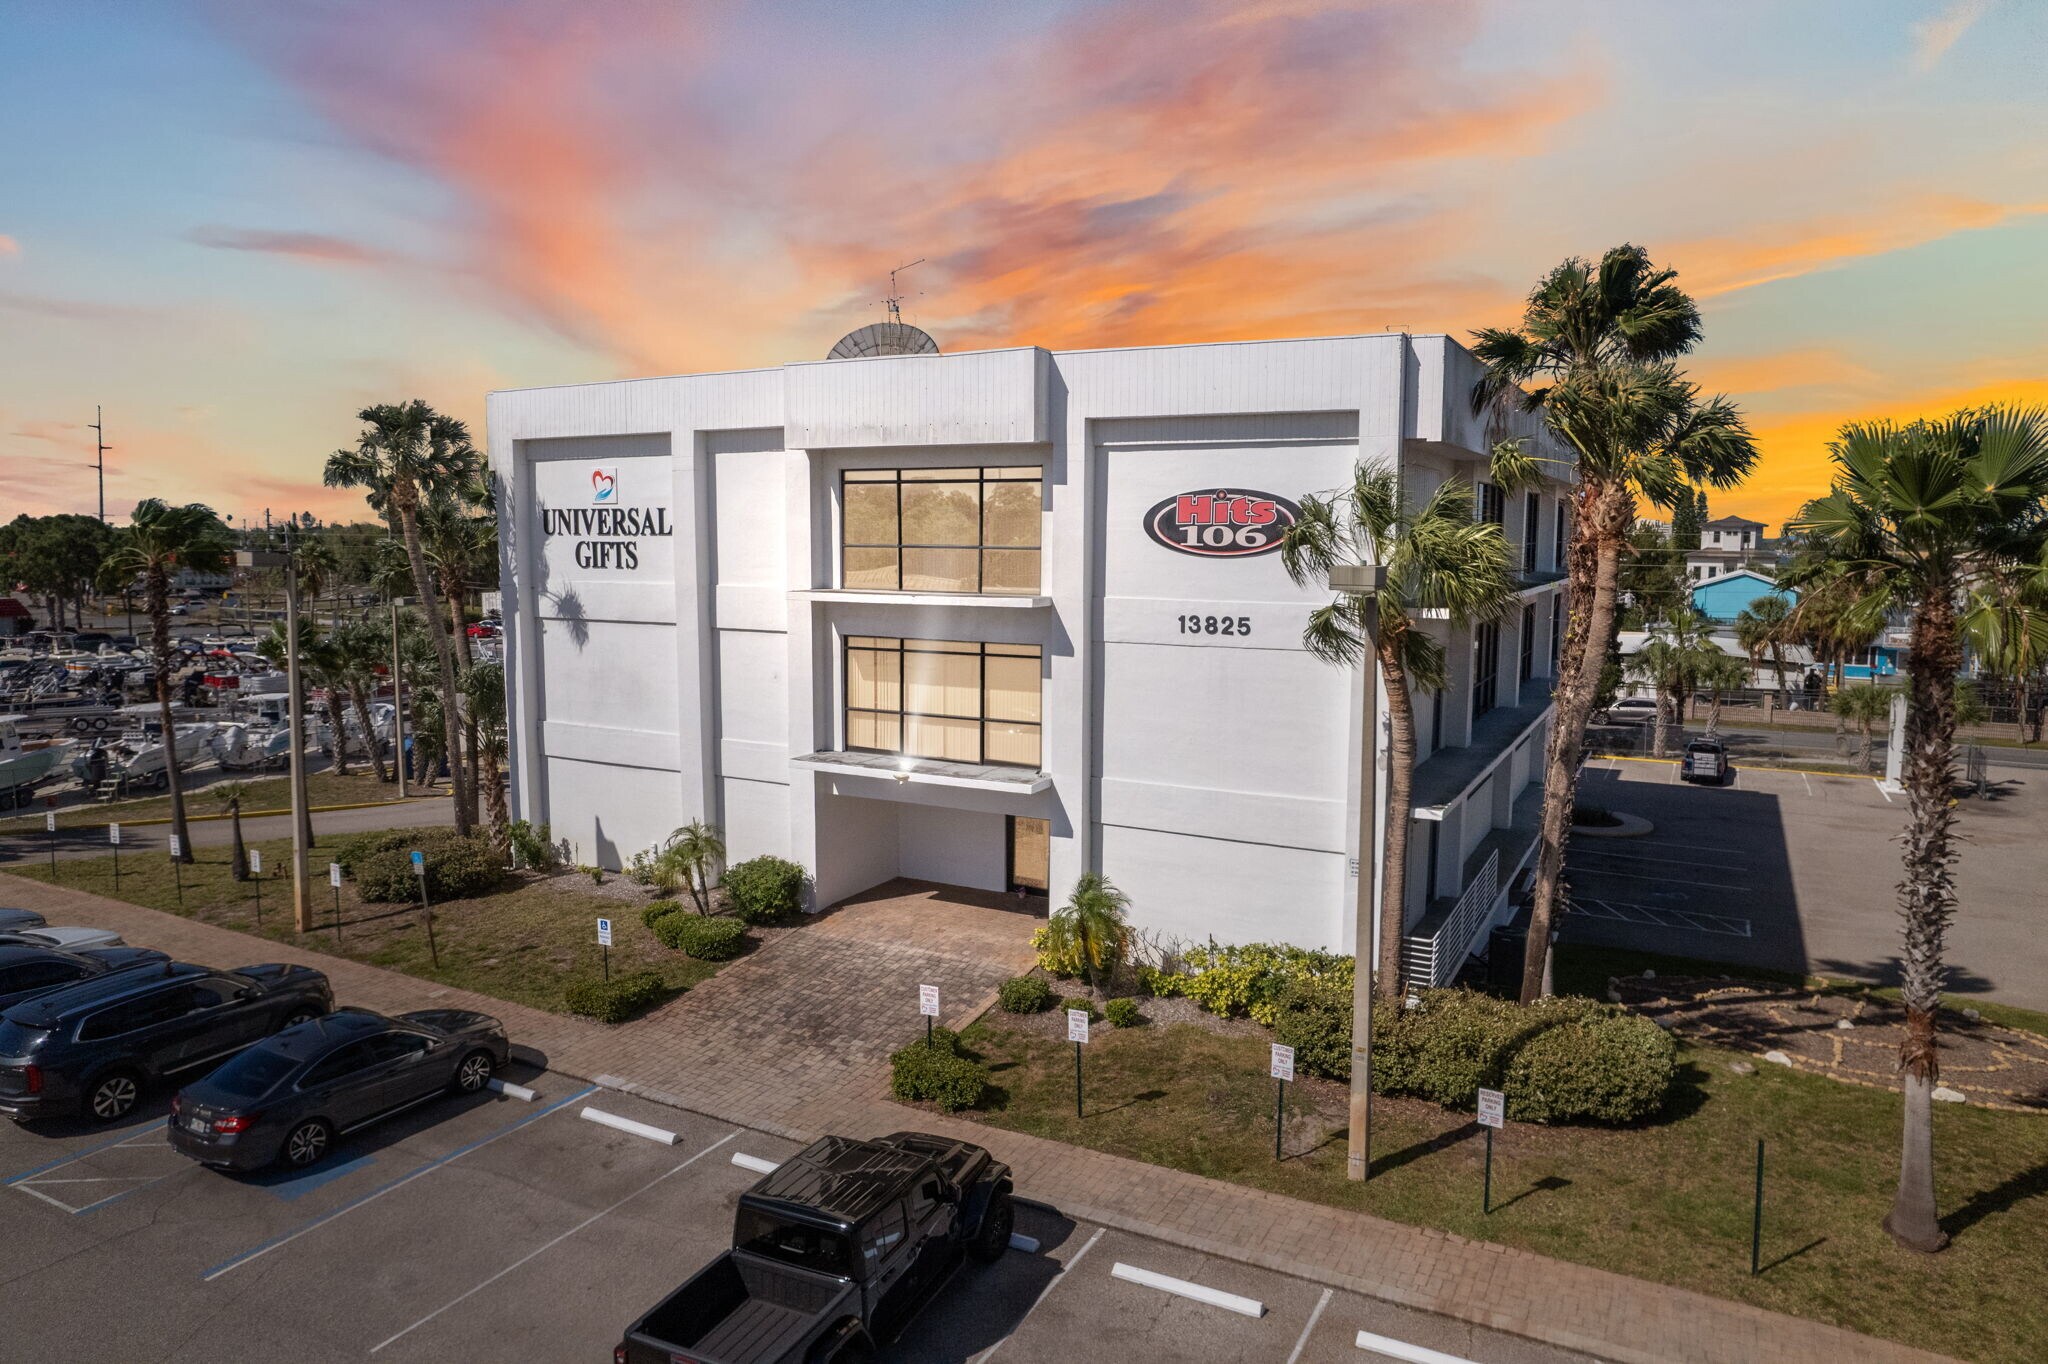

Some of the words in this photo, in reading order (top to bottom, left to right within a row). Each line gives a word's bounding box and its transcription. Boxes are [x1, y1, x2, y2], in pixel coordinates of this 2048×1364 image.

[542, 507, 673, 536] UNIVERSAL
[1176, 489, 1277, 525] Hits
[1179, 525, 1267, 547] 106
[575, 540, 639, 570] GIFTS
[1178, 614, 1251, 636] 13825
